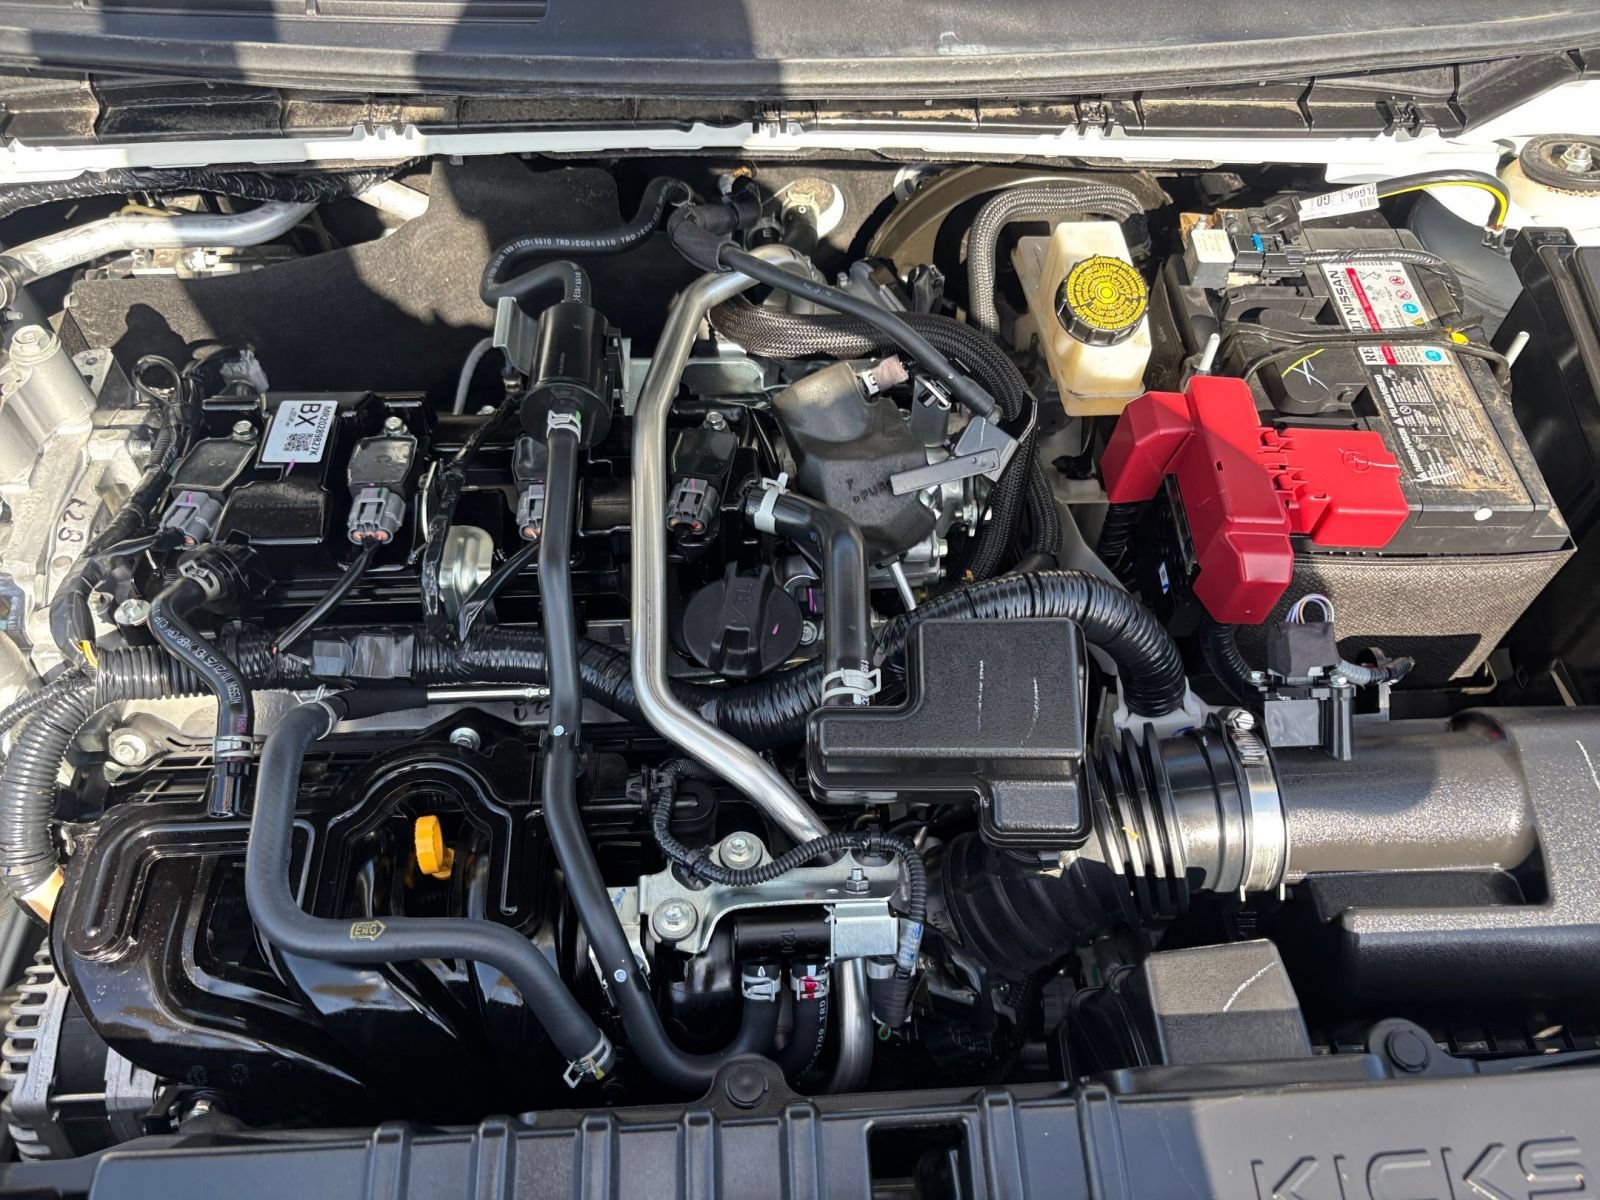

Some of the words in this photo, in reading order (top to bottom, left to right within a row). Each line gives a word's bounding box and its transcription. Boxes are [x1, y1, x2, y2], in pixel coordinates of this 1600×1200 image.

[1329, 270, 1356, 317] NISSAN
[295, 403, 322, 427] BX
[355, 924, 377, 936] ENG
[1250, 1137, 1586, 1200] KICKS
